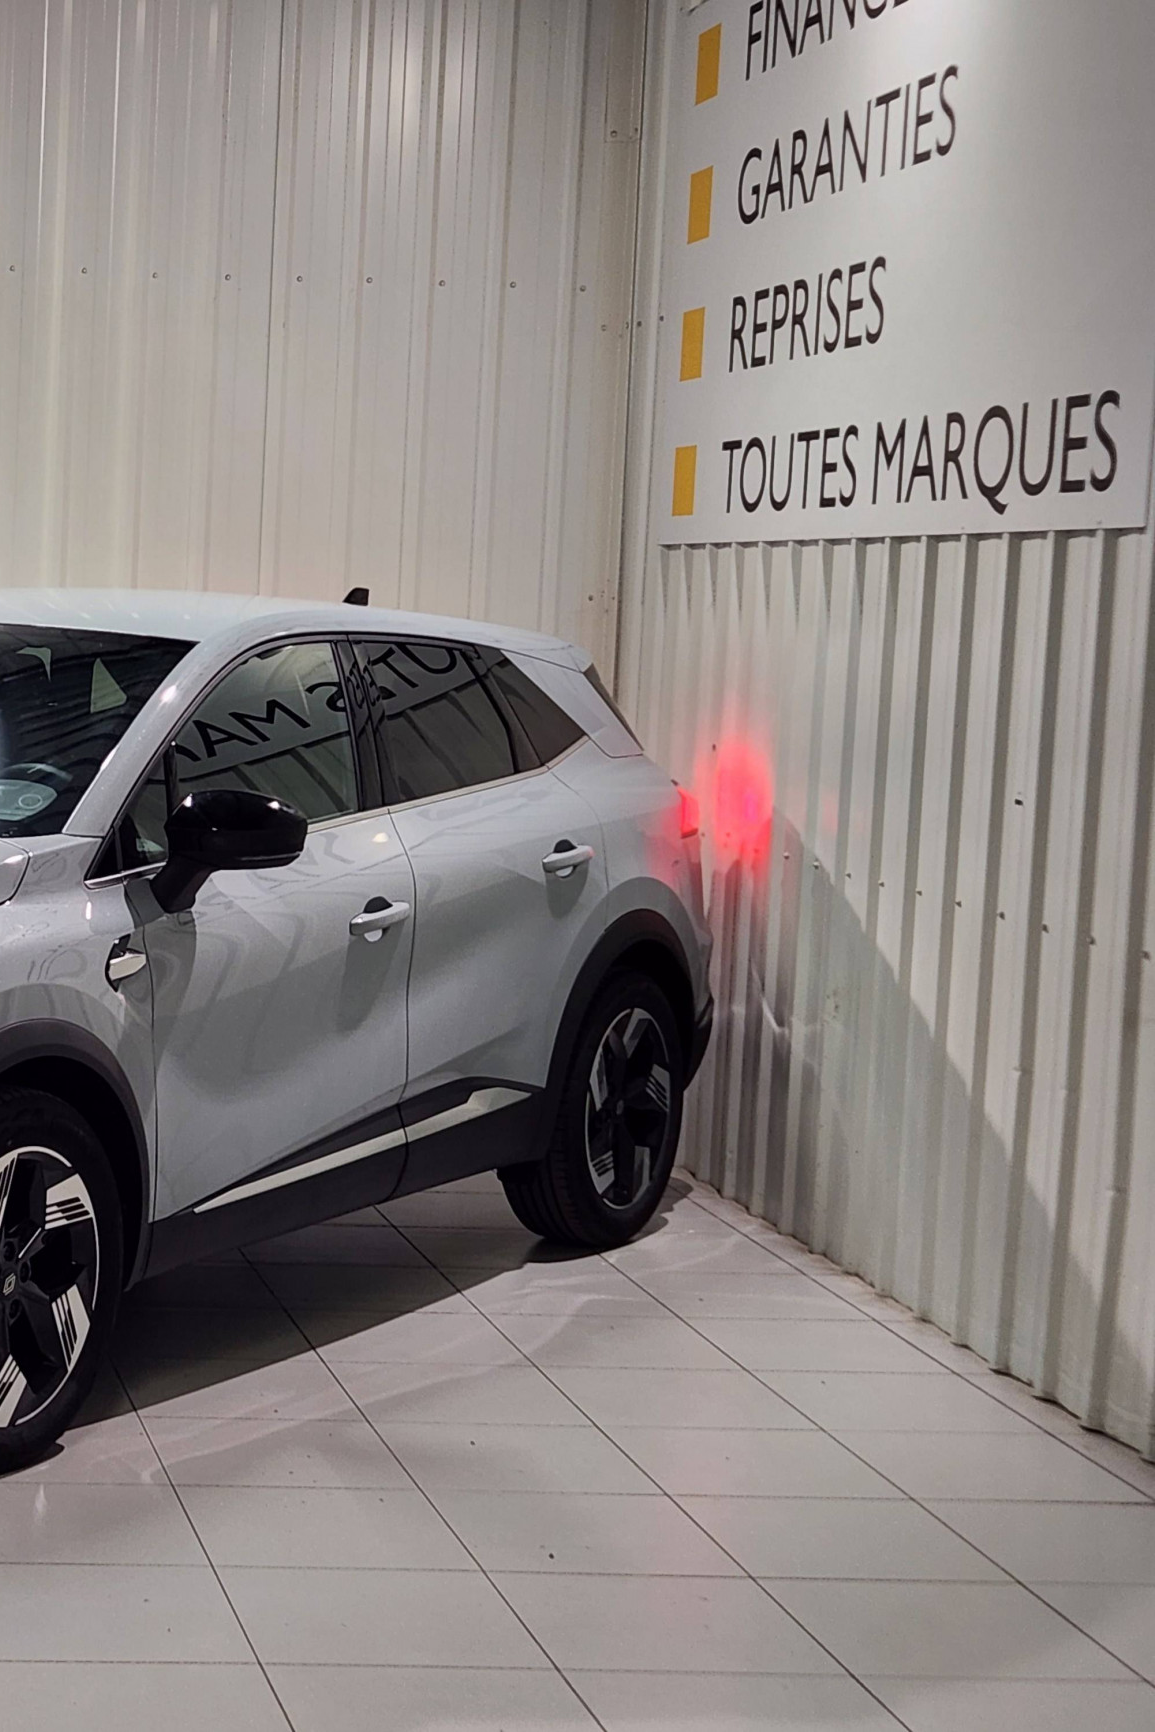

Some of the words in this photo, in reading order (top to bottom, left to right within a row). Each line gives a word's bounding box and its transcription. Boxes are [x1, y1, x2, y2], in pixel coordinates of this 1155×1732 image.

[737, 64, 959, 225] GARANTIES
[728, 256, 887, 374] REPRISES
[721, 424, 859, 514] TOUTES
[871, 389, 1121, 516] MARQUES
